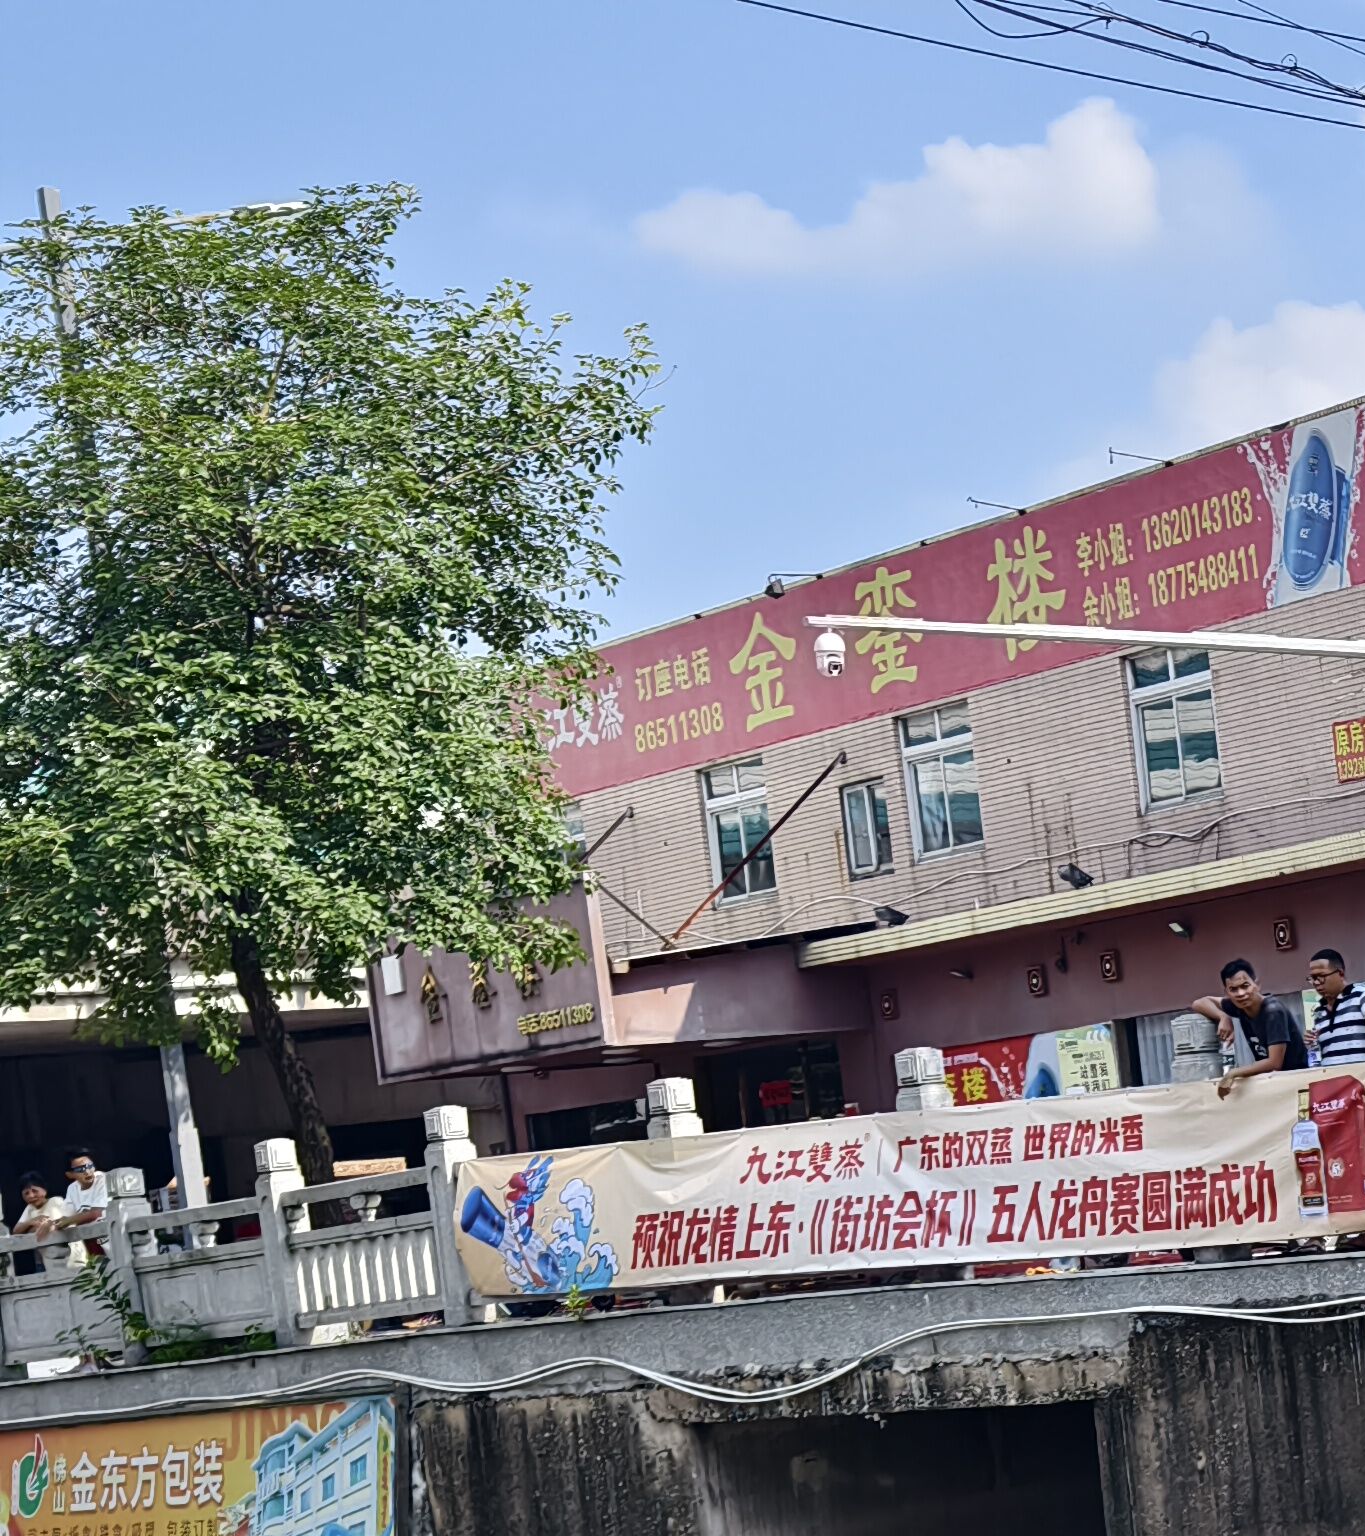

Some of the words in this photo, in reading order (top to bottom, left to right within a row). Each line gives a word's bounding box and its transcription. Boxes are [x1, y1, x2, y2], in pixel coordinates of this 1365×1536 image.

[1141, 487, 1252, 553] 13620143183
[1148, 544, 1259, 607] 18775488411
[635, 647, 711, 702] 订座电话
[634, 702, 723, 752] 86511308
[894, 1126, 1014, 1174] 广东的双蒸
[1022, 1113, 1144, 1163] 世界的米香
[70, 1438, 224, 1514] 金东方包装
